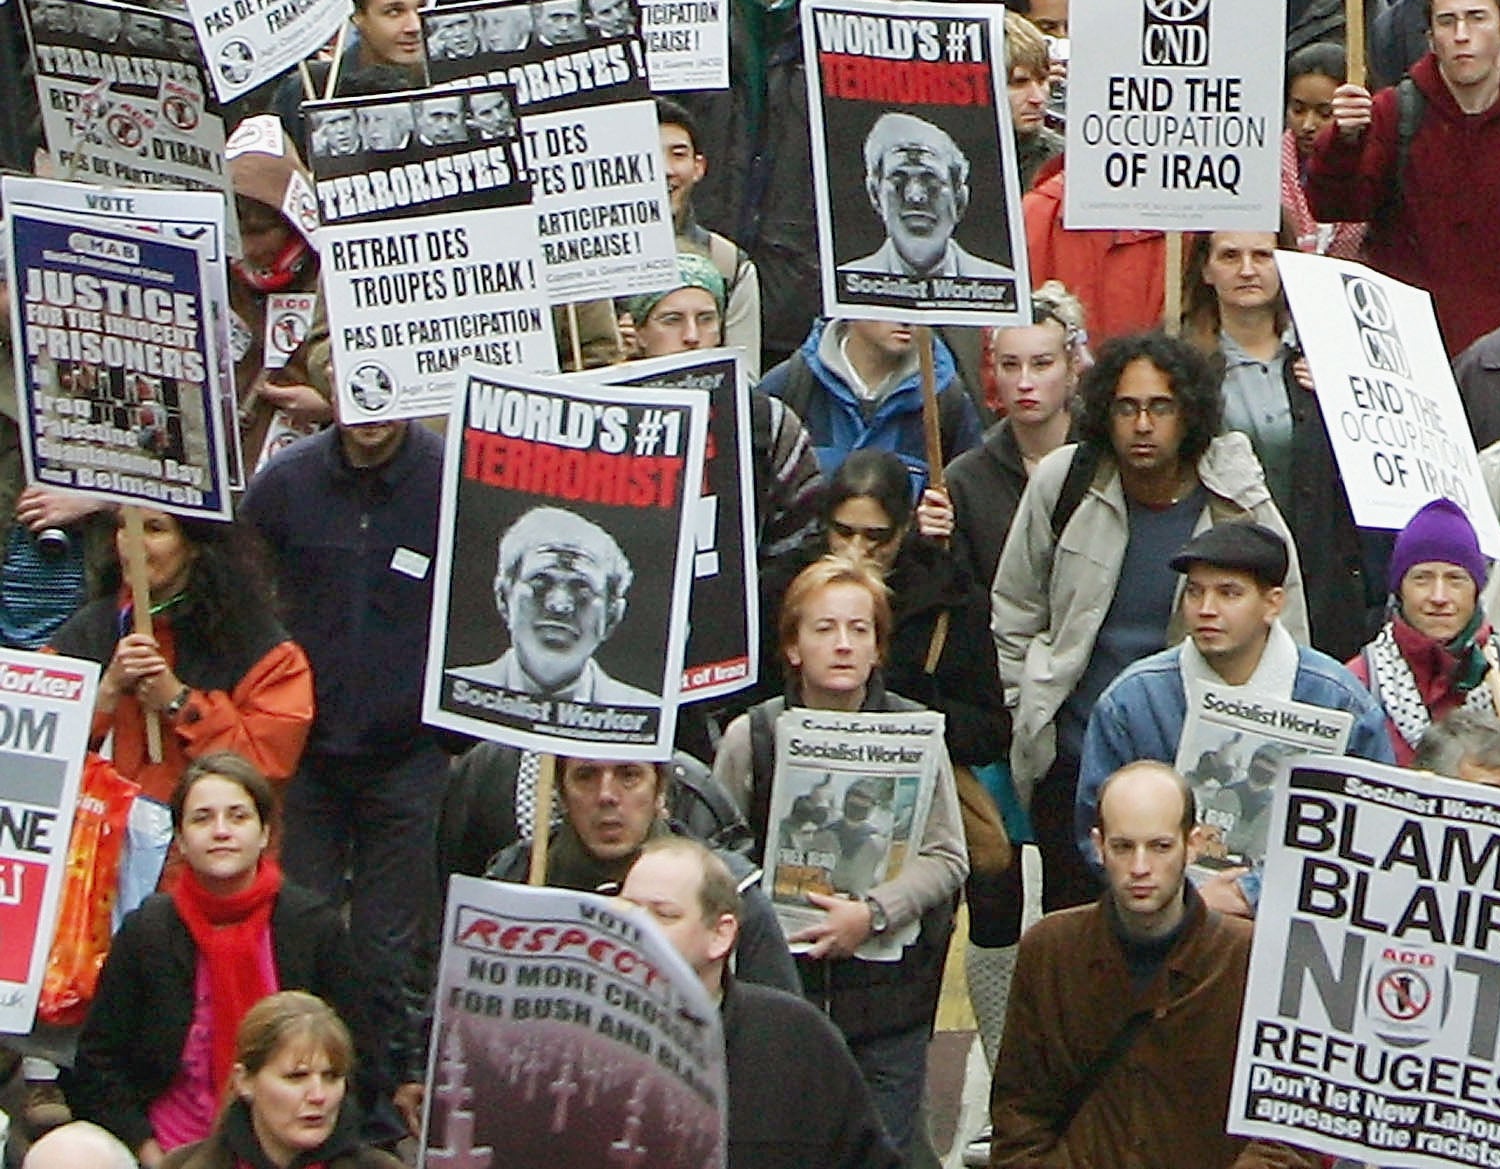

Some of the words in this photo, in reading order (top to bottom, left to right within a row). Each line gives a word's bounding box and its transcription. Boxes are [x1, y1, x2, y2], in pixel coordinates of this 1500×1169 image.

[815, 12, 942, 60] WORLD'S
[945, 22, 986, 63] #1
[1143, 24, 1208, 65] CND
[821, 52, 991, 107] TERRORIST
[1108, 76, 1174, 112] END
[1184, 76, 1243, 113] THE
[1082, 112, 1266, 147] OCCUPATION
[317, 145, 506, 221] TERRORISTES
[1105, 153, 1148, 188] OF
[1161, 153, 1243, 195] IRAQ
[332, 231, 421, 272] RETRAIT
[427, 228, 470, 260] DES
[25, 268, 197, 328] JUSTICE
[350, 266, 450, 309] TROUPES
[454, 262, 527, 295] D'IRAK
[846, 274, 930, 299] Socialist
[934, 279, 1008, 302] Worker
[28, 331, 206, 381] PRISONERS
[468, 381, 629, 454] WORLD'S
[634, 407, 682, 456] #1
[463, 428, 685, 509] TERRORIST
[451, 680, 553, 722] Socialist
[558, 699, 649, 733] Worker
[1202, 692, 1275, 725] Socialist
[1277, 709, 1342, 741] Worker
[788, 738, 864, 761] Socialist
[865, 744, 925, 764] Worker
[1343, 777, 1438, 815] Socialist
[455, 917, 676, 991] RESPECT
[1382, 948, 1436, 967] ACG
[1252, 1067, 1322, 1103] Don't
[1325, 1082, 1361, 1113] let
[1362, 1092, 1420, 1125] New
[1256, 1097, 1362, 1139] appease
[1368, 1119, 1411, 1147] the
